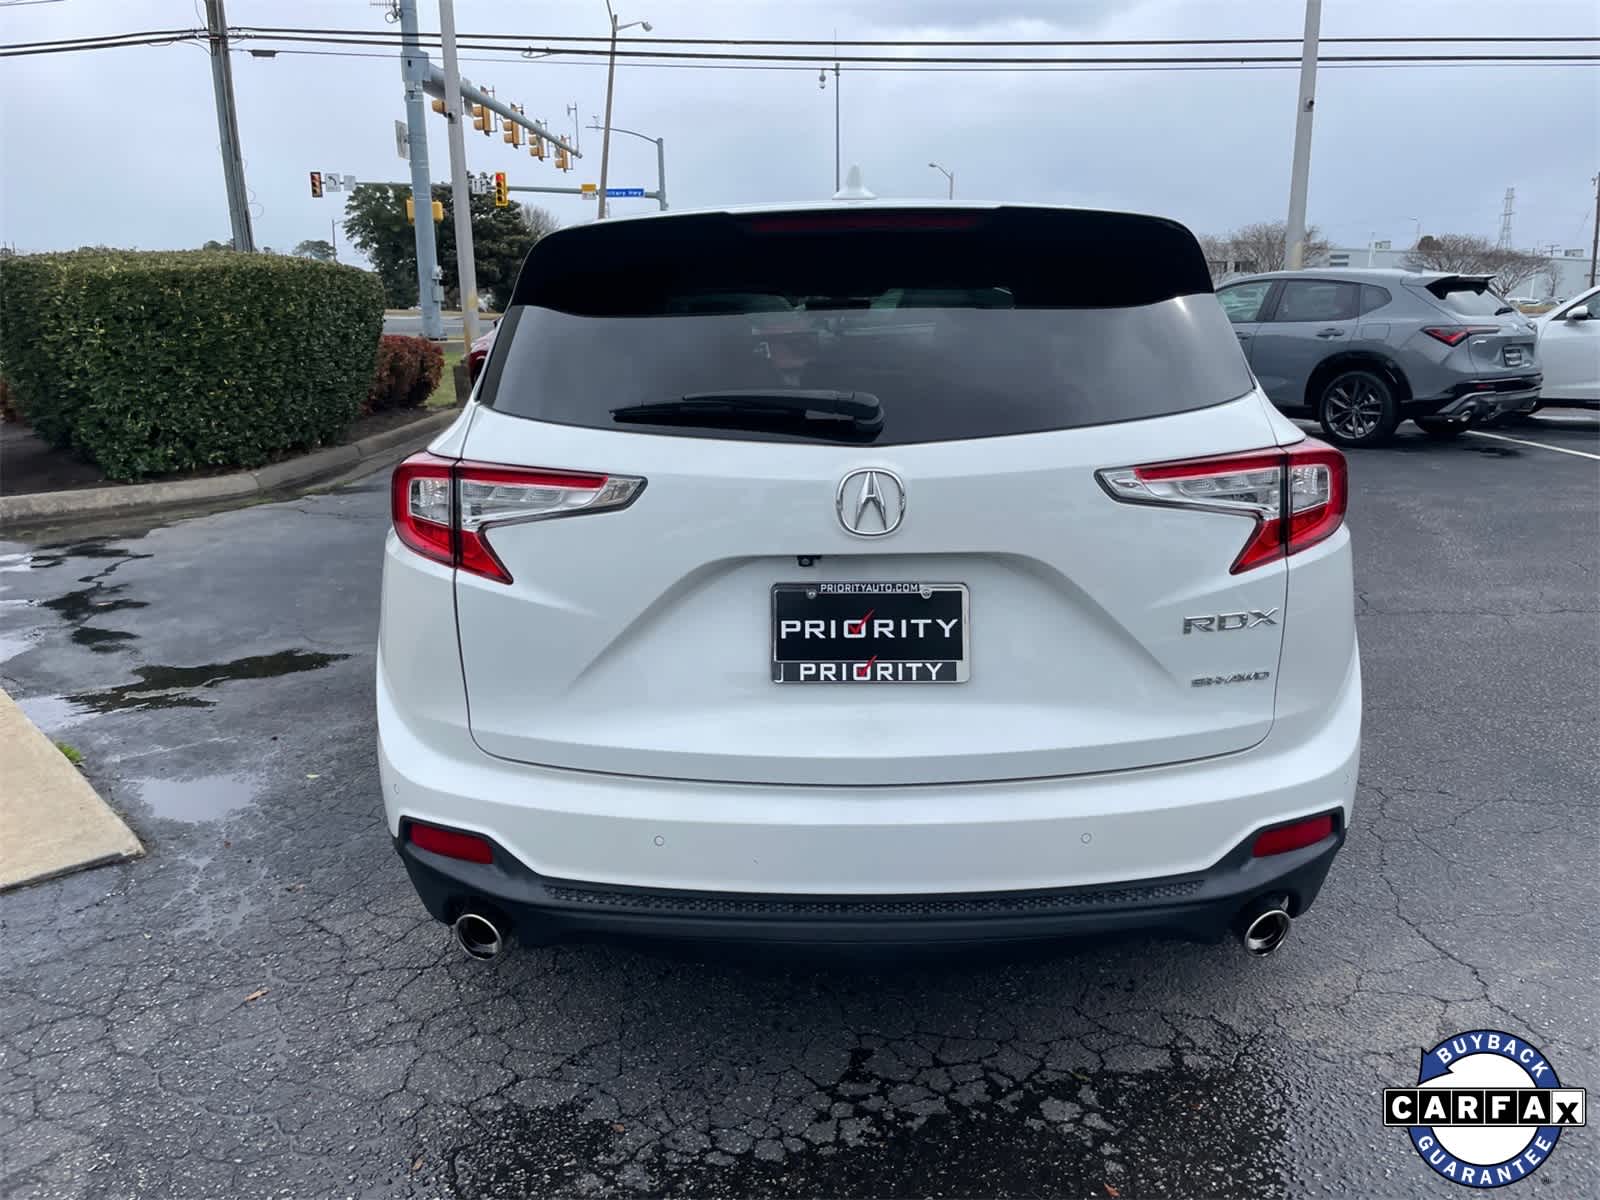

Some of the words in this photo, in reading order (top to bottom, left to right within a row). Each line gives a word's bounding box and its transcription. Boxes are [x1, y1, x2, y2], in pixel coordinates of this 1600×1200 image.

[820, 584, 918, 592] PRIORITYAUTO.COM
[780, 619, 959, 639] PRIORITY
[1183, 608, 1279, 635] RDX
[800, 663, 943, 681] PRIORITY
